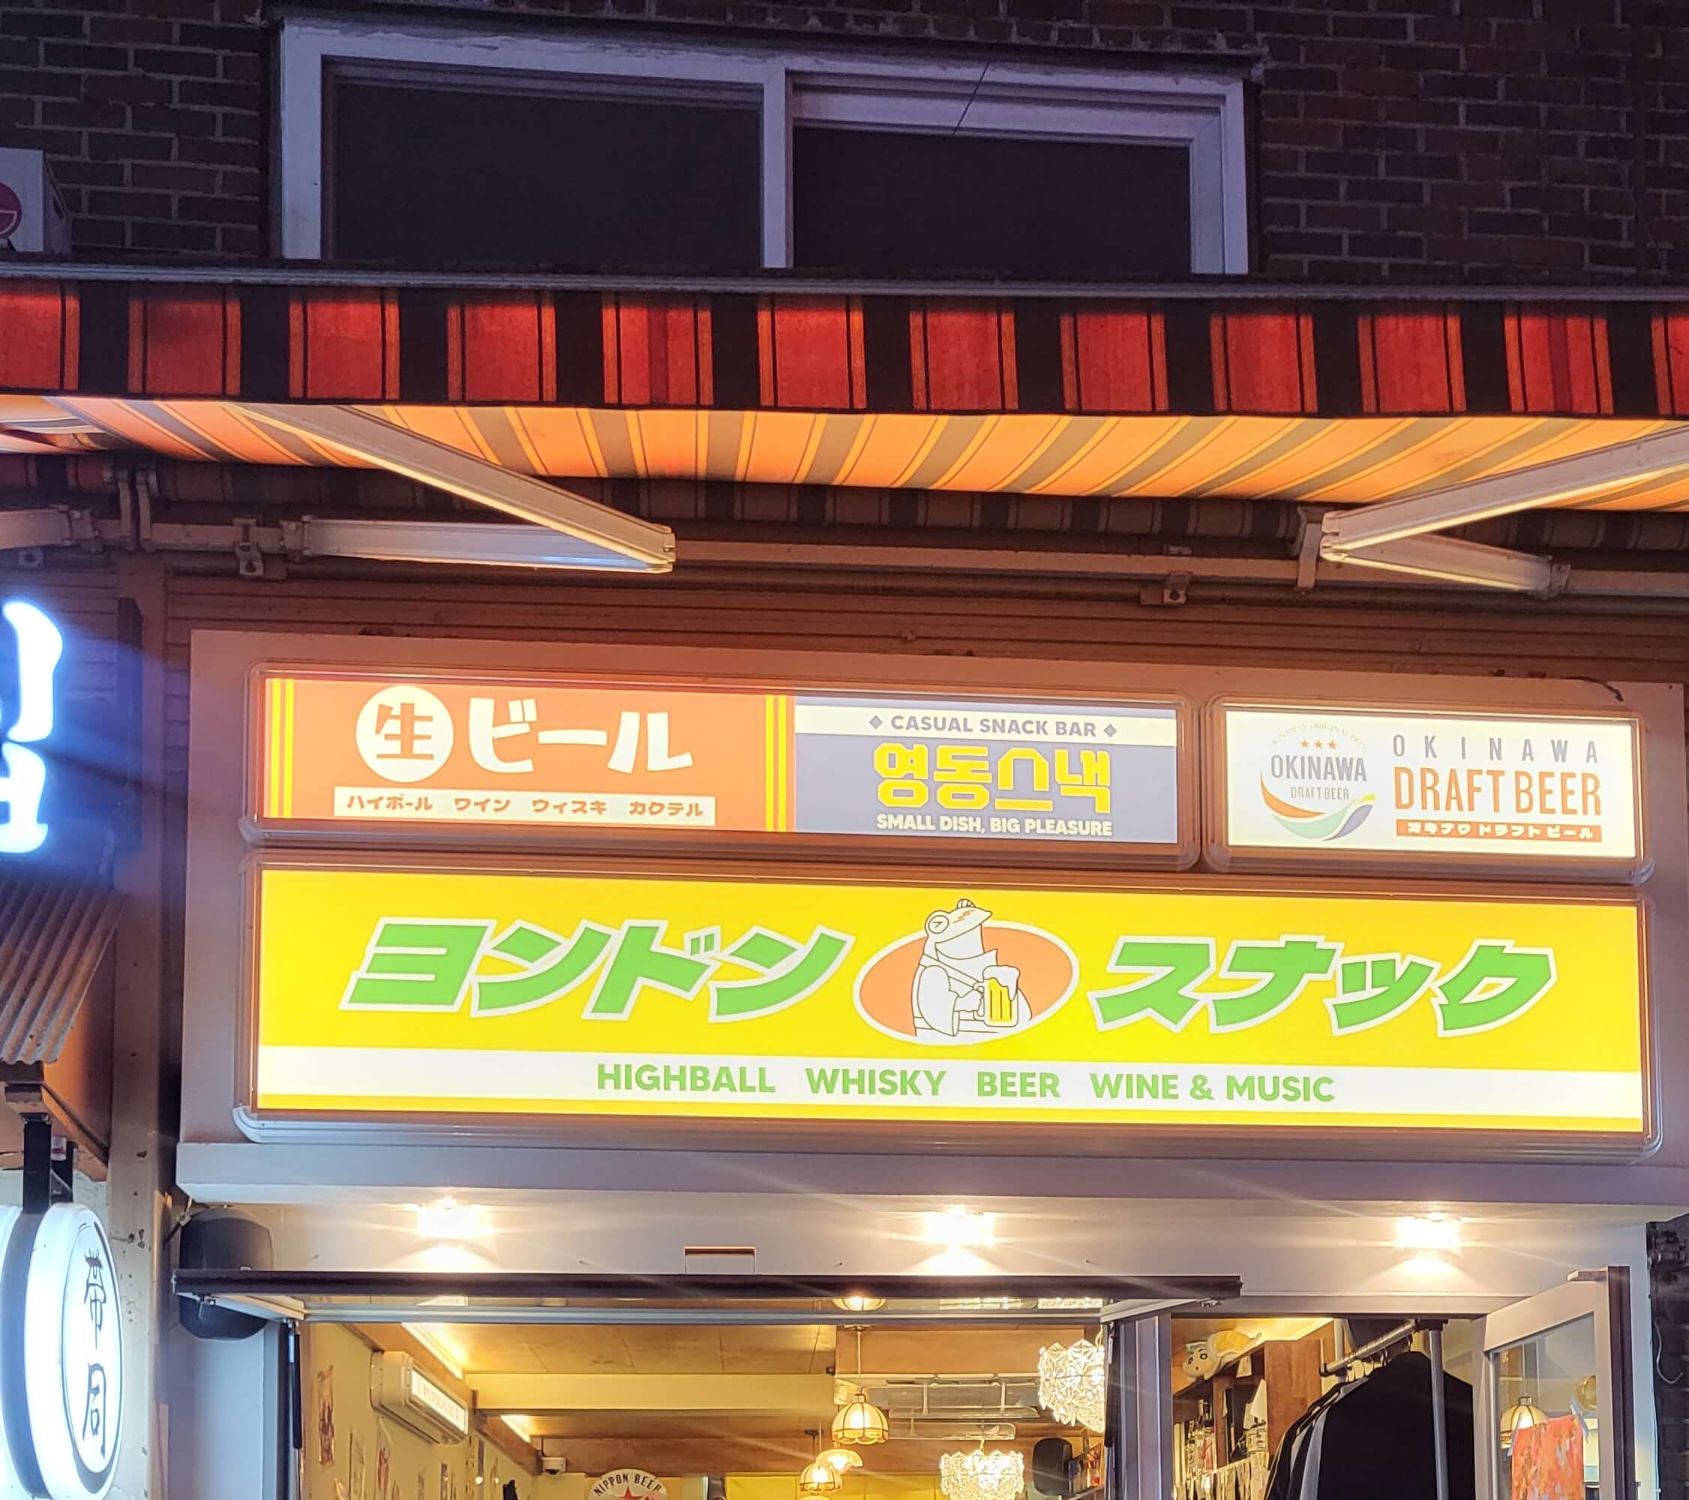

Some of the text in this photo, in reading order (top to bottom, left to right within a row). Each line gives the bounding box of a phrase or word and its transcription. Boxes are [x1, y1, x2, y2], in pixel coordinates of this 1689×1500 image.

[891, 715, 1097, 737] CASUAL SNACK BAR
[1393, 734, 1599, 764] OKINAWA
[873, 742, 1111, 814] 영동스낵
[1270, 754, 1368, 782] OKINAWA
[1290, 786, 1350, 800] DRAFT BEER
[1394, 766, 1601, 816] DRAFT BEER
[454, 797, 511, 813] ワイン
[532, 799, 607, 815] ウィスキ
[629, 800, 704, 817] カクテル
[876, 814, 1113, 837] SMALL DISH, BIG PLEASURE
[342, 918, 1556, 1036] ヨンドン スナック
[597, 1063, 1336, 1102] HIGHBALL WHISKY BEER WINE & MUSIC
[593, 1472, 629, 1497] NIPPON
